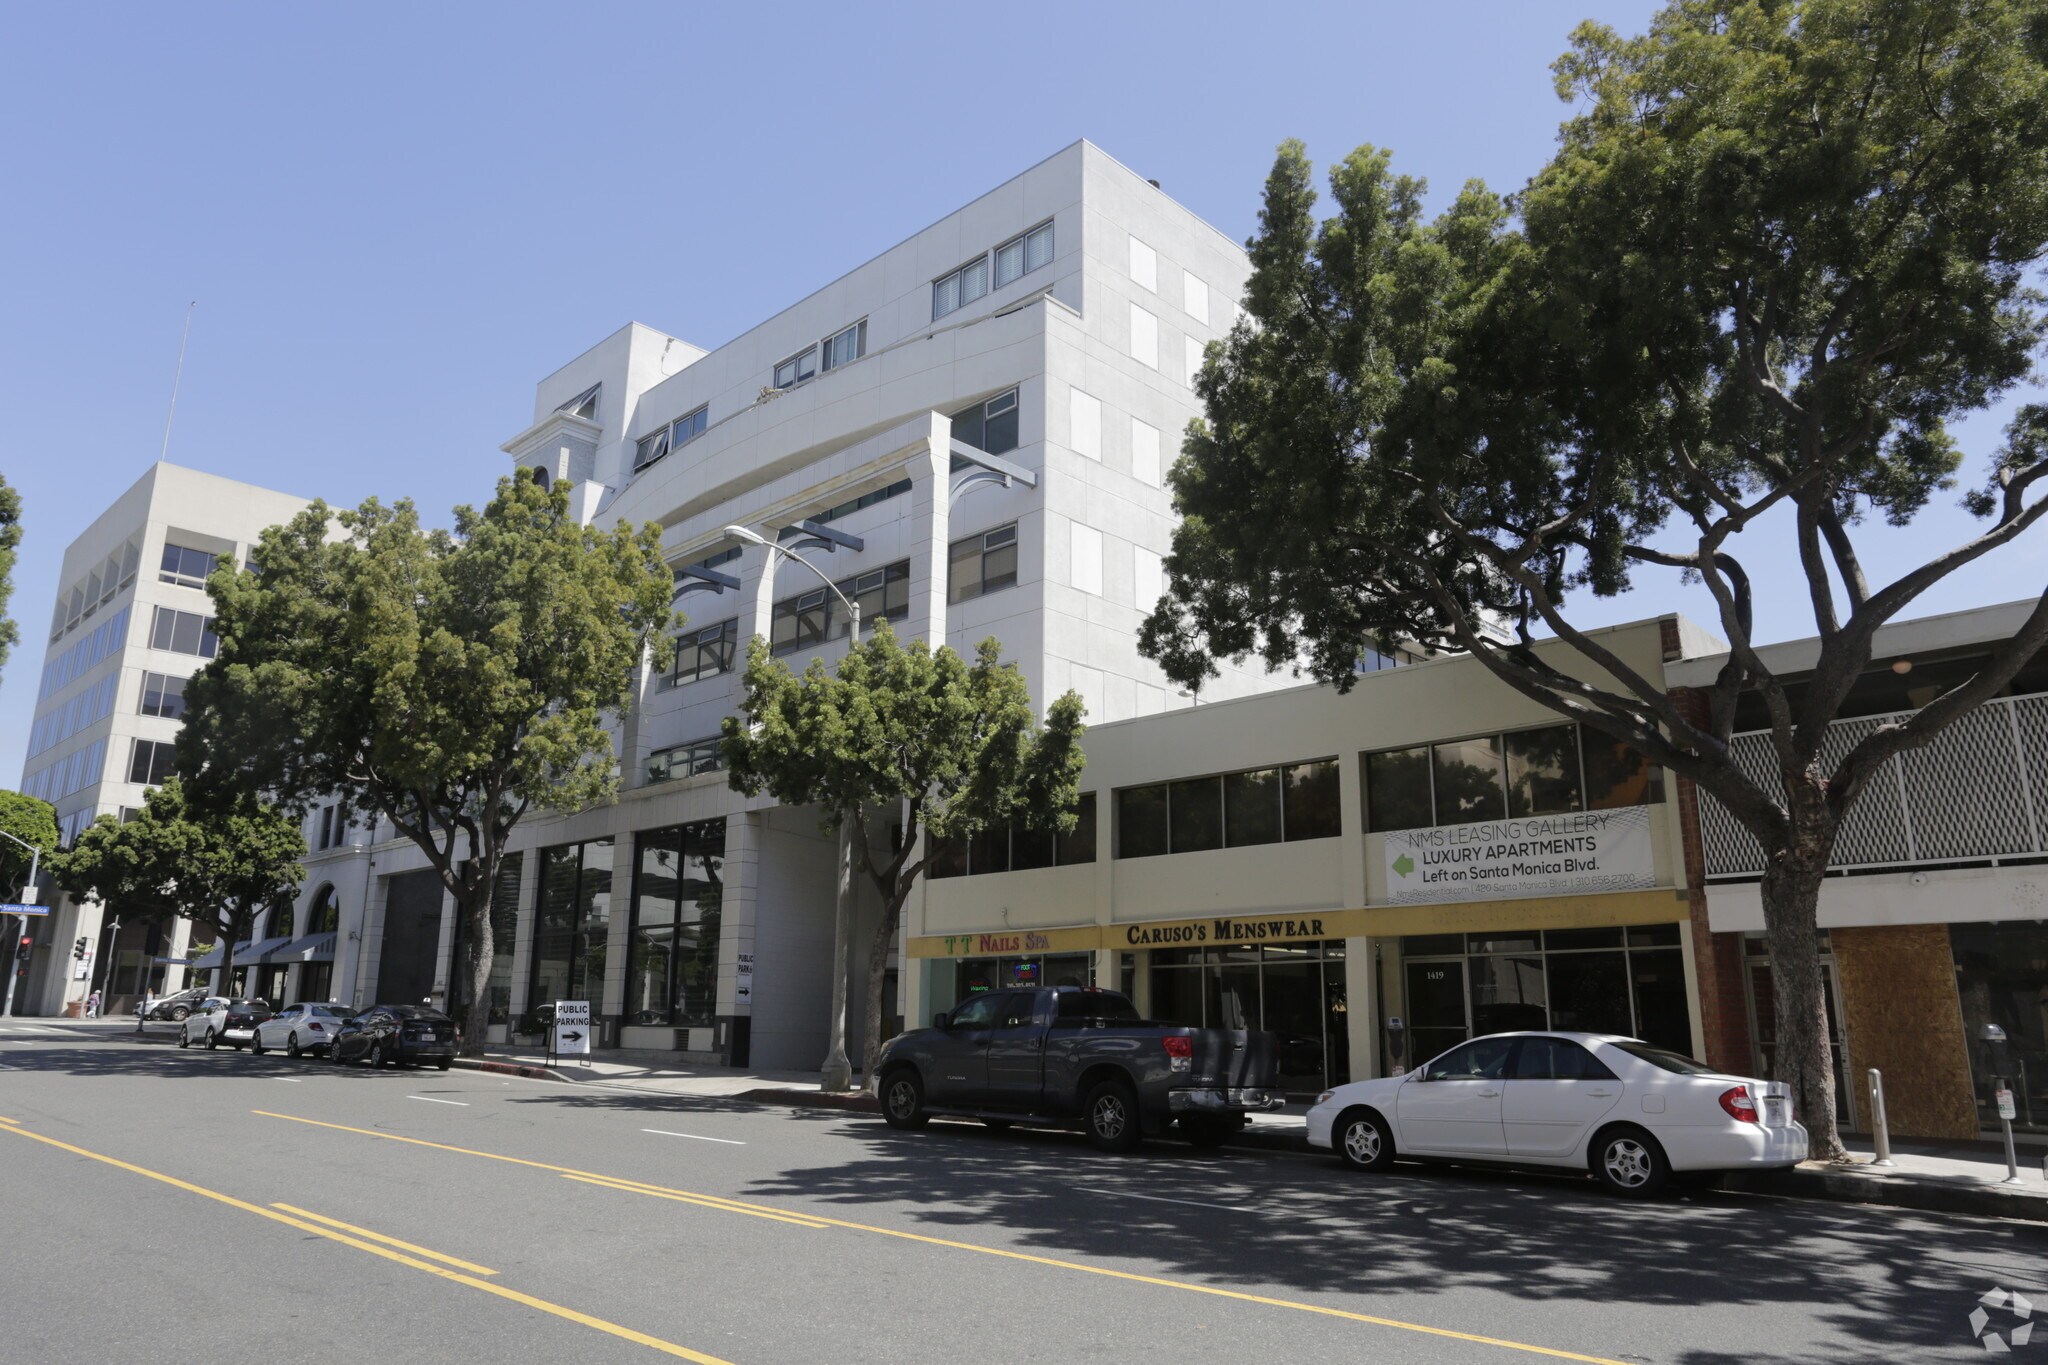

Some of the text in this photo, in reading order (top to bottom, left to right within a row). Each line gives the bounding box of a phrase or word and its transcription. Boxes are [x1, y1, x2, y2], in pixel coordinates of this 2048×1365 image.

[1408, 813, 1610, 848] NMS LEASING GALLERY
[1422, 836, 1597, 865] LUXURY APARTMENTS
[1423, 857, 1600, 882] Left on Santa Monica Blvd.
[1475, 883, 1492, 892] 420
[1493, 882, 1518, 892] Santa
[1519, 879, 1548, 890] Monica
[3, 904, 48, 913] Santa Monica
[945, 935, 957, 954] T
[961, 935, 973, 954] T
[1427, 971, 1444, 980] 1419
[558, 1005, 588, 1014] PUBLIC
[556, 1017, 589, 1026] PARKING
